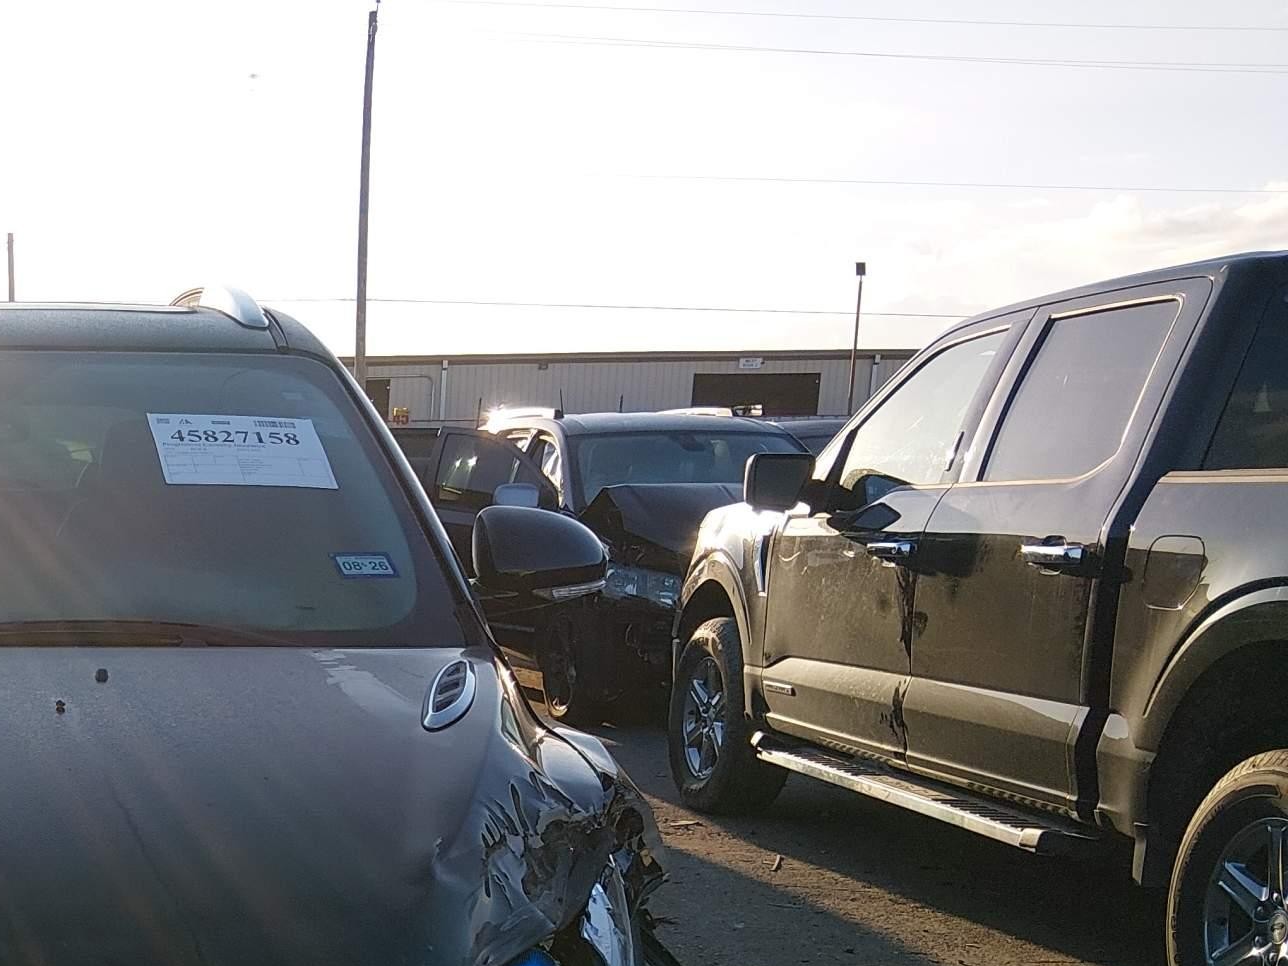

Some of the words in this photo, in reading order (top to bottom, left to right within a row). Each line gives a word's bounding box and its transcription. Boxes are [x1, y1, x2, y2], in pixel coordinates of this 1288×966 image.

[170, 429, 300, 446] 45827158
[342, 561, 362, 571] 08
[368, 561, 389, 571] 26
